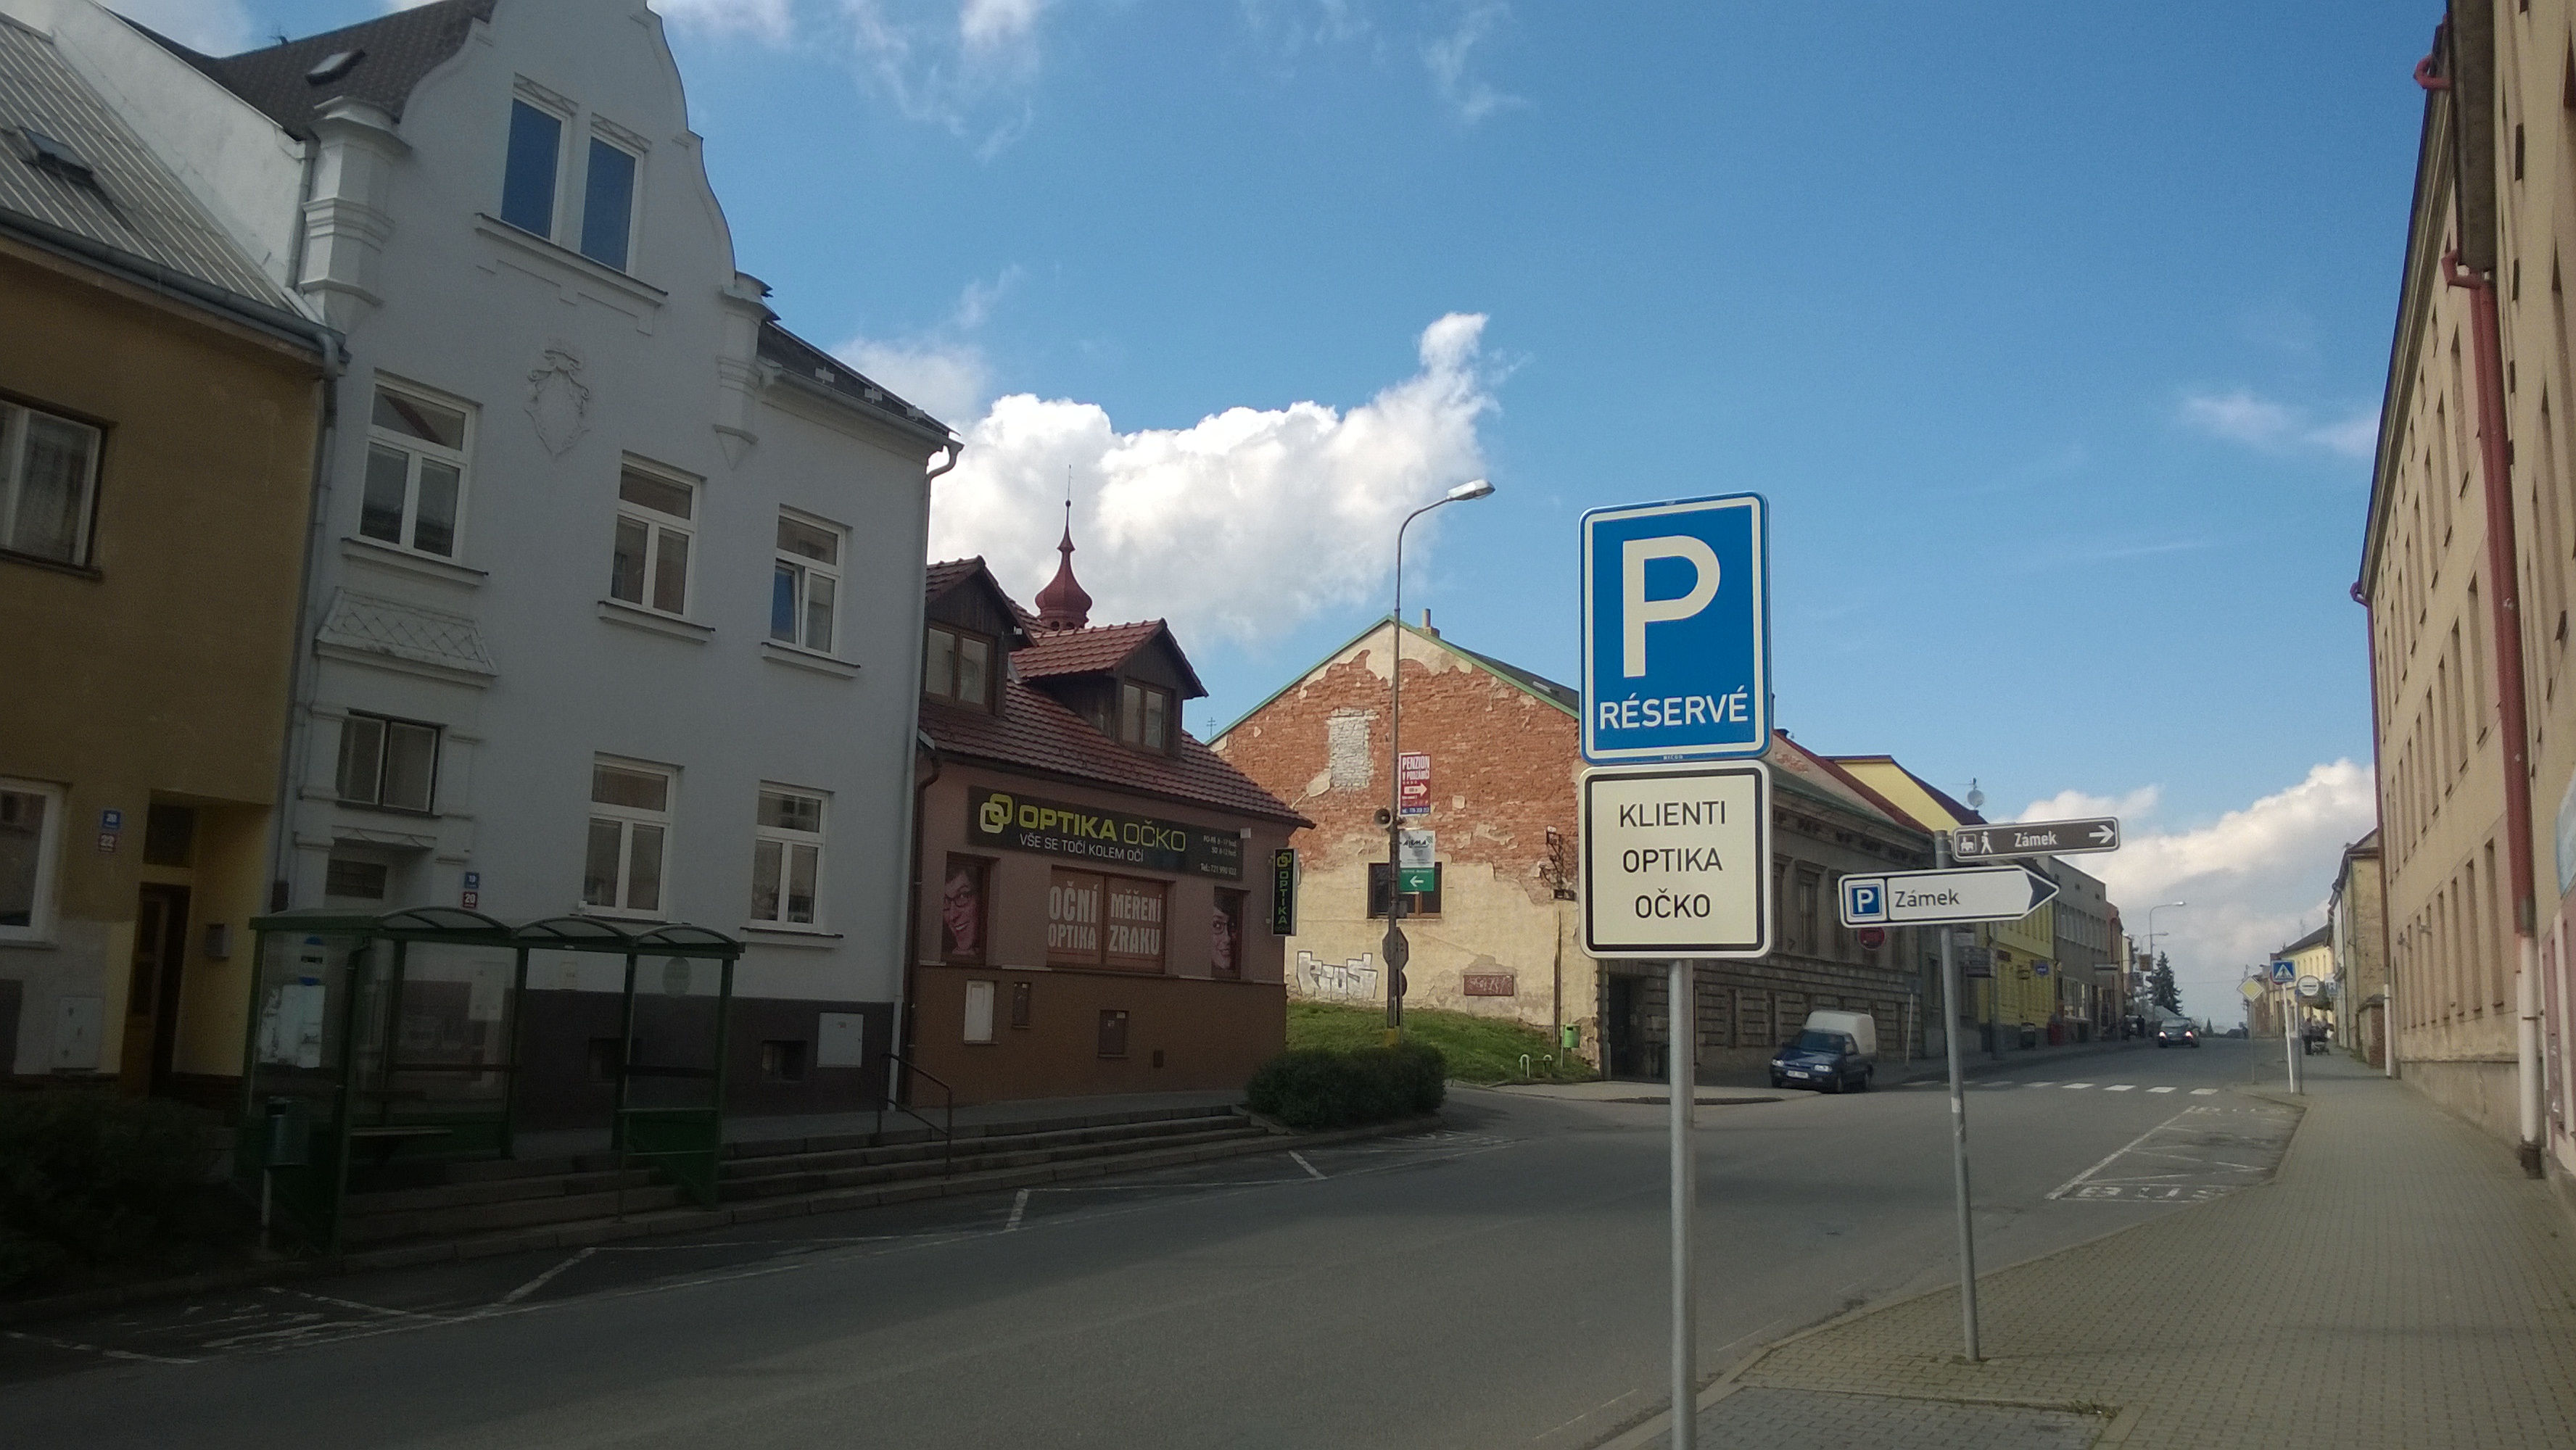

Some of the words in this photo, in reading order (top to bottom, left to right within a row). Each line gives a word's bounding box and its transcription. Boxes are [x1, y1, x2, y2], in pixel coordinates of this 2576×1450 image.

[1623, 535, 1721, 678] P
[1600, 684, 1749, 729] RÉSERVÉ
[1402, 755, 1430, 771] PENZION
[1019, 804, 1118, 842] OPTIKA
[1124, 819, 1186, 852] OČKO
[1620, 800, 1725, 827] KLIENTI
[1020, 832, 1041, 848] VŠE
[1044, 839, 1058, 850] SE
[1062, 839, 1086, 855] TOČÍ
[1089, 844, 1124, 861] KOLEM
[1127, 849, 1144, 862] OČÍ
[2014, 831, 2058, 848] Zámek
[1623, 847, 1723, 873] OPTIKA
[465, 893, 476, 903] 20
[1049, 880, 1099, 924] OČNÍ
[1110, 888, 1162, 923] MĚŘENÍ
[1278, 871, 1289, 924] OPTIKA
[1635, 887, 1711, 919] OČKO
[1857, 889, 1874, 912] P
[1894, 888, 1960, 908] Zámek
[1048, 923, 1097, 950] OPTIKA
[1108, 924, 1160, 956] ZRAKU
